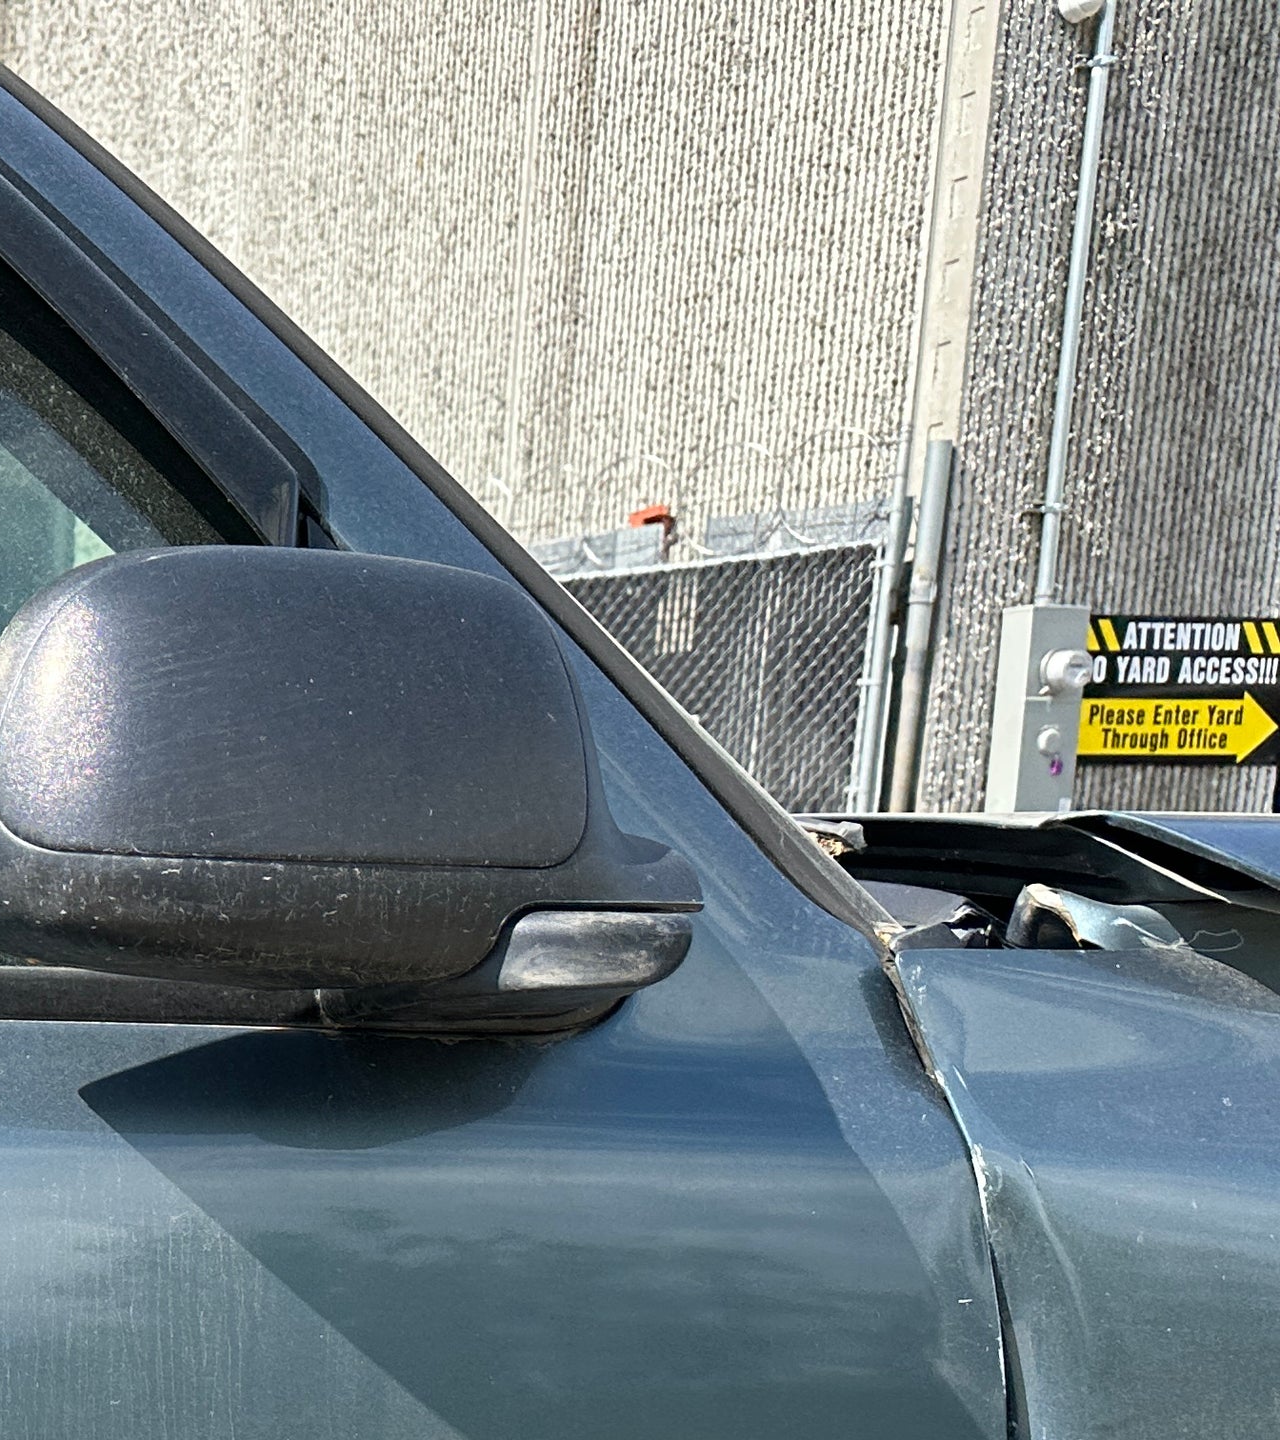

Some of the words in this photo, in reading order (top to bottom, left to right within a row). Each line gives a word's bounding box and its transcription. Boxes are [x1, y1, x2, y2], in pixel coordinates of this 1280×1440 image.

[1123, 621, 1241, 651] ATTENTION
[1092, 655, 1108, 684] O
[1116, 655, 1171, 684] YARD
[1178, 657, 1279, 685] ACCESS!!!
[1088, 704, 1145, 725] Please
[1152, 705, 1200, 725] Enter
[1207, 705, 1244, 725] Yard
[1101, 729, 1168, 752] Through
[1177, 729, 1228, 749] Office
